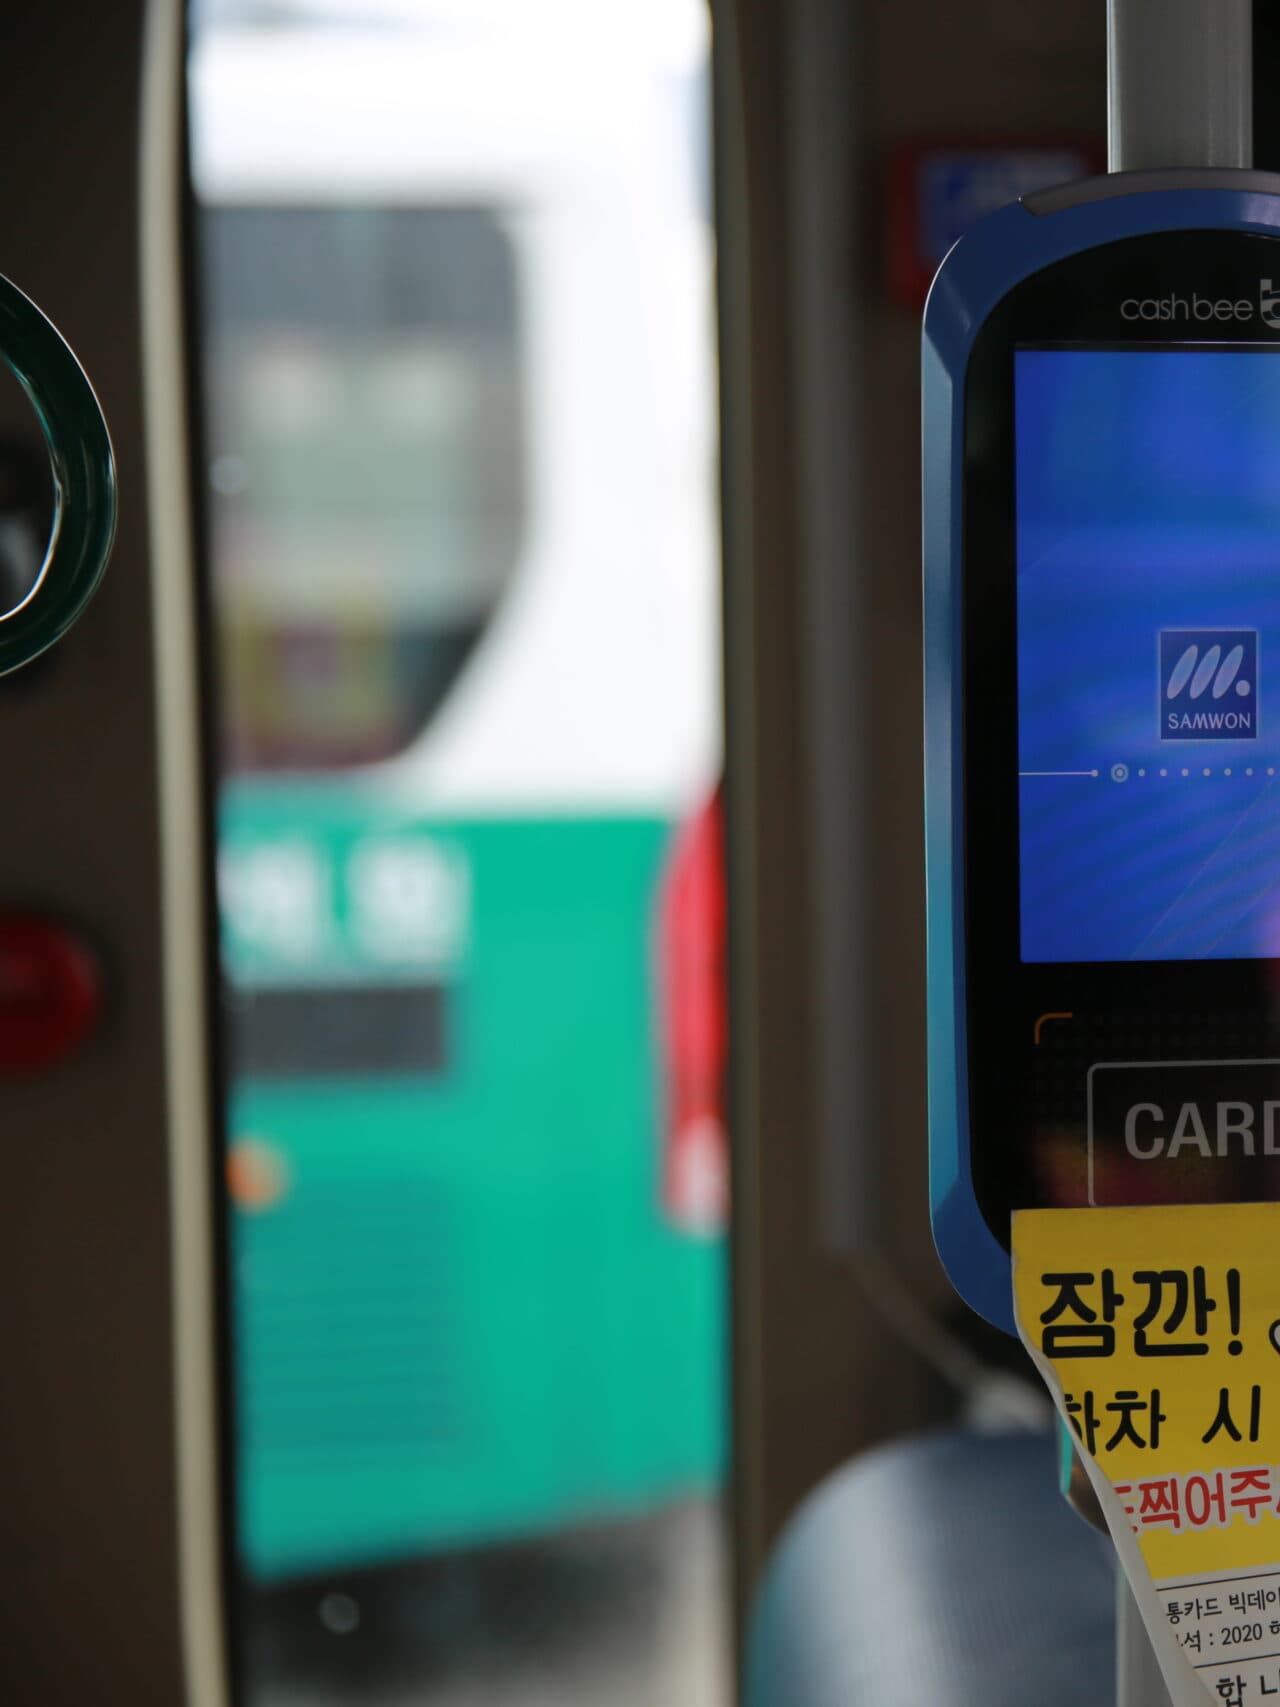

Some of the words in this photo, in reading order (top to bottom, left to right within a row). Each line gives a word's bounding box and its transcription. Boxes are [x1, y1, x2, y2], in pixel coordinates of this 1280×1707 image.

[1168, 712, 1251, 729] SAMWON
[1039, 1265, 1244, 1358] 잠깐!
[1202, 1384, 1261, 1443] 시
[1175, 1629, 1202, 1654] 석
[1220, 1623, 1263, 1647] 2020
